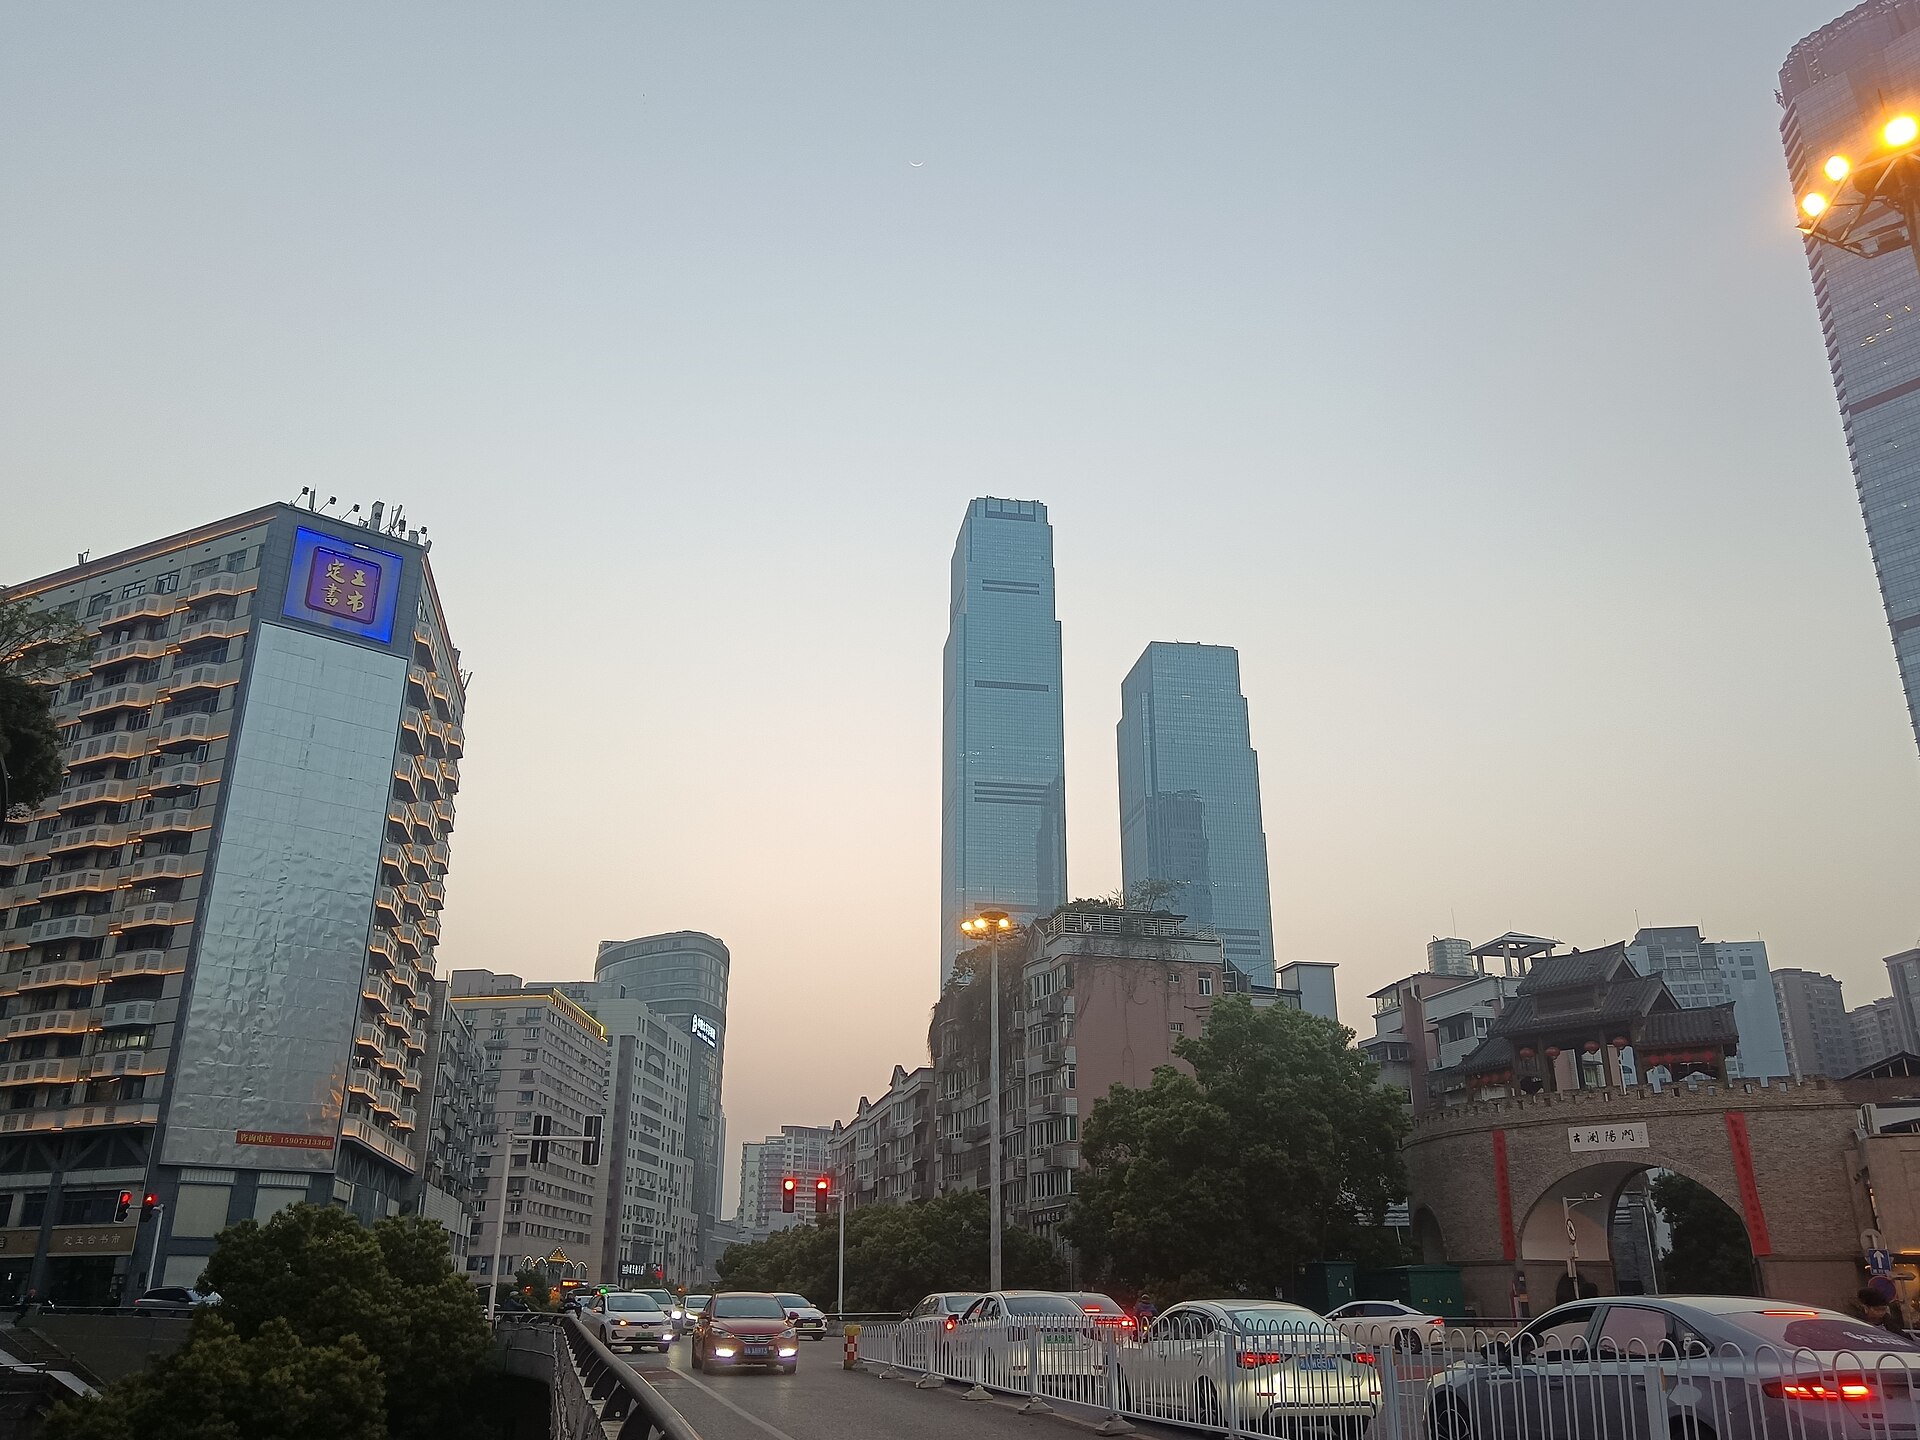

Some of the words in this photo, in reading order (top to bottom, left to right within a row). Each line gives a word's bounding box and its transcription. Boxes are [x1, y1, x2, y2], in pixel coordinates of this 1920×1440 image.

[63, 1233, 121, 1246] 定王台书市
